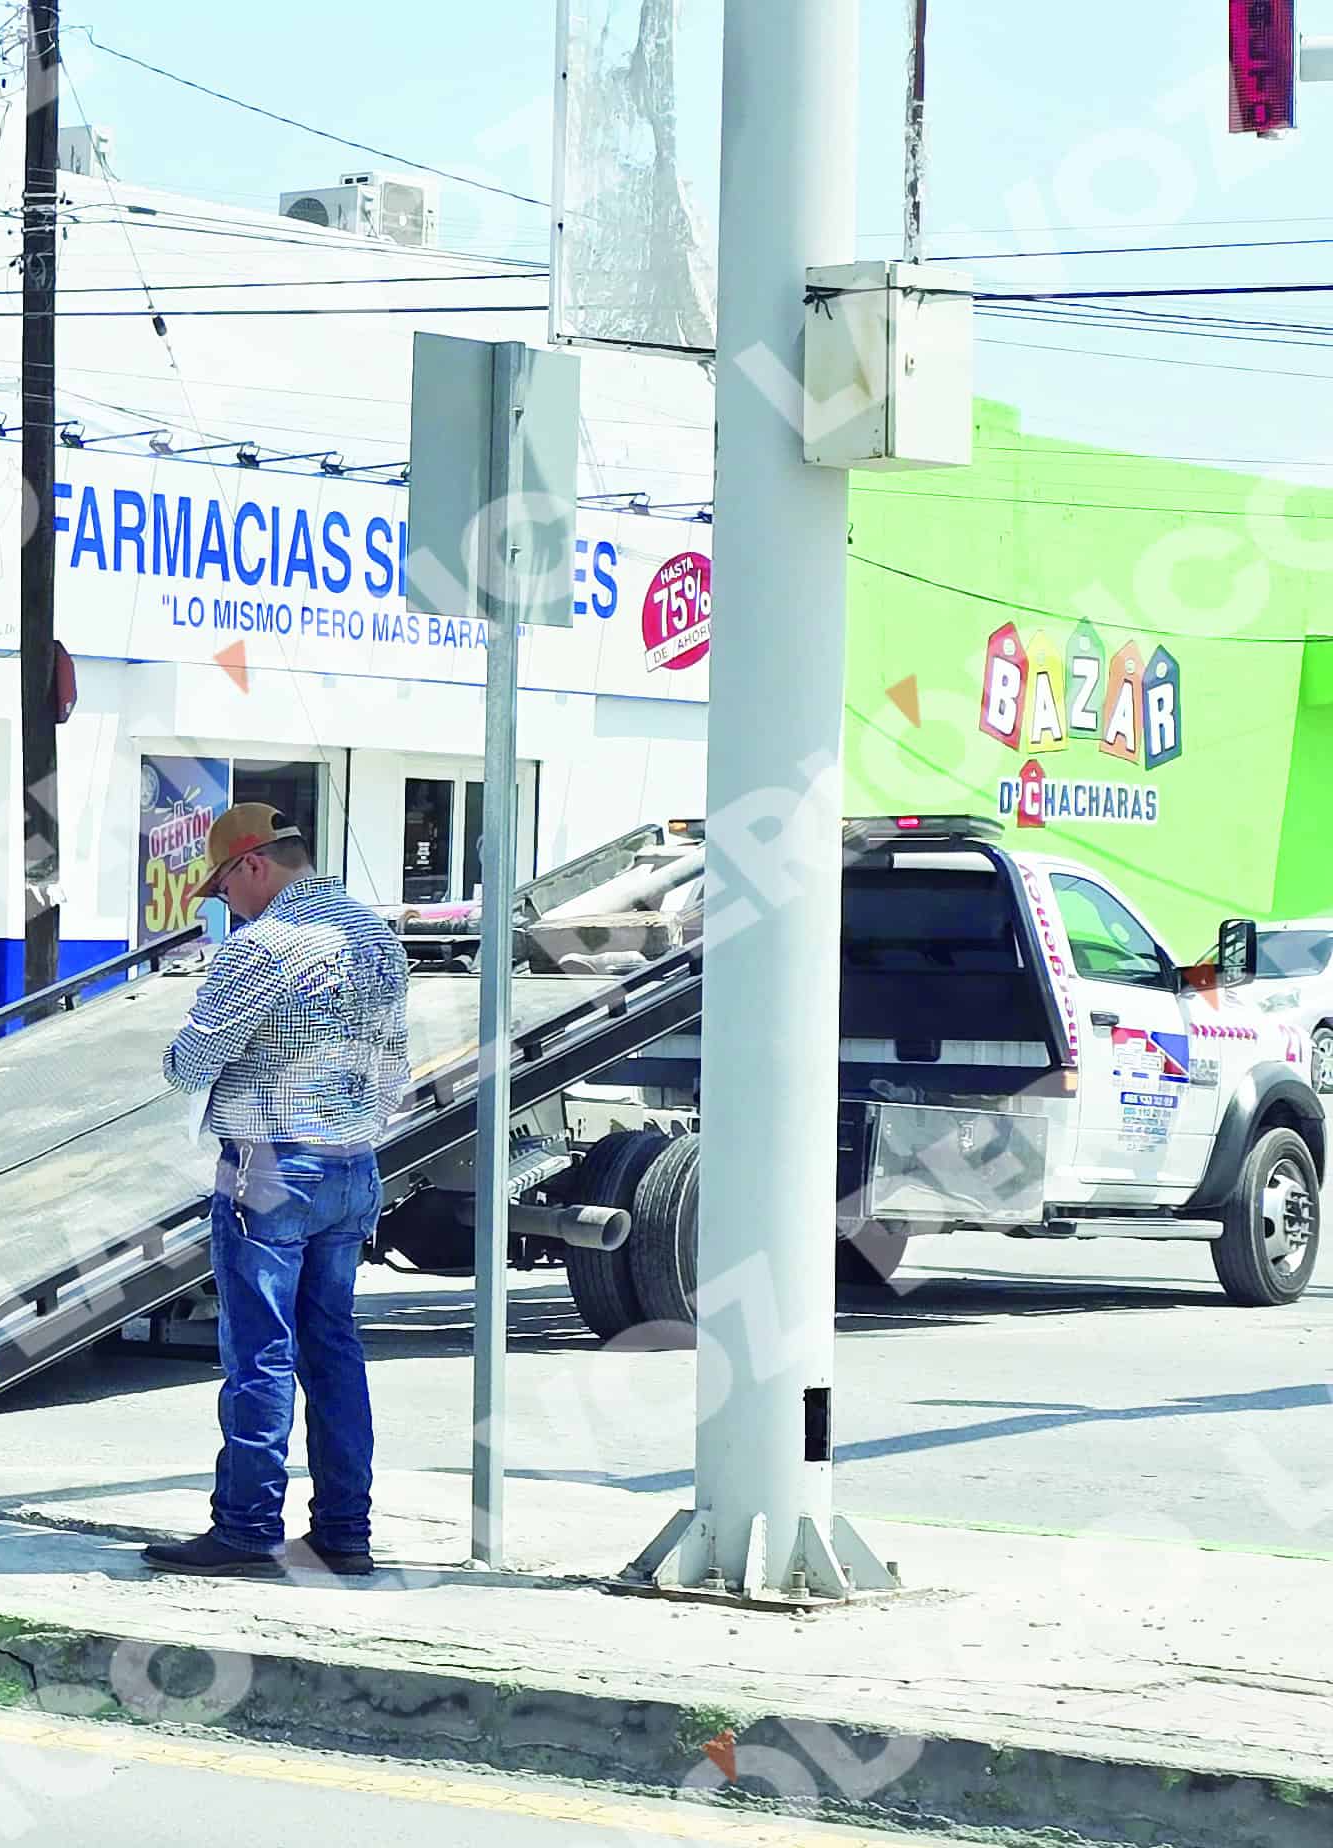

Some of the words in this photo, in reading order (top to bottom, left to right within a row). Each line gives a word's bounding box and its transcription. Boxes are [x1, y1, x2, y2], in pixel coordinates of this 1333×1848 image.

[660, 556, 693, 585] HASTA
[161, 594, 205, 629] "LO
[213, 598, 292, 635] MISMO
[300, 605, 364, 642] PERO
[372, 612, 420, 646] MAS
[653, 569, 712, 638] 75%
[653, 646, 670, 664] DE
[677, 623, 710, 650] AHOR
[988, 655, 1177, 758] BAZAR
[999, 780, 1157, 822] D'CHACHARAS
[149, 806, 214, 859] OFERTÓN
[145, 859, 207, 933] 3x2
